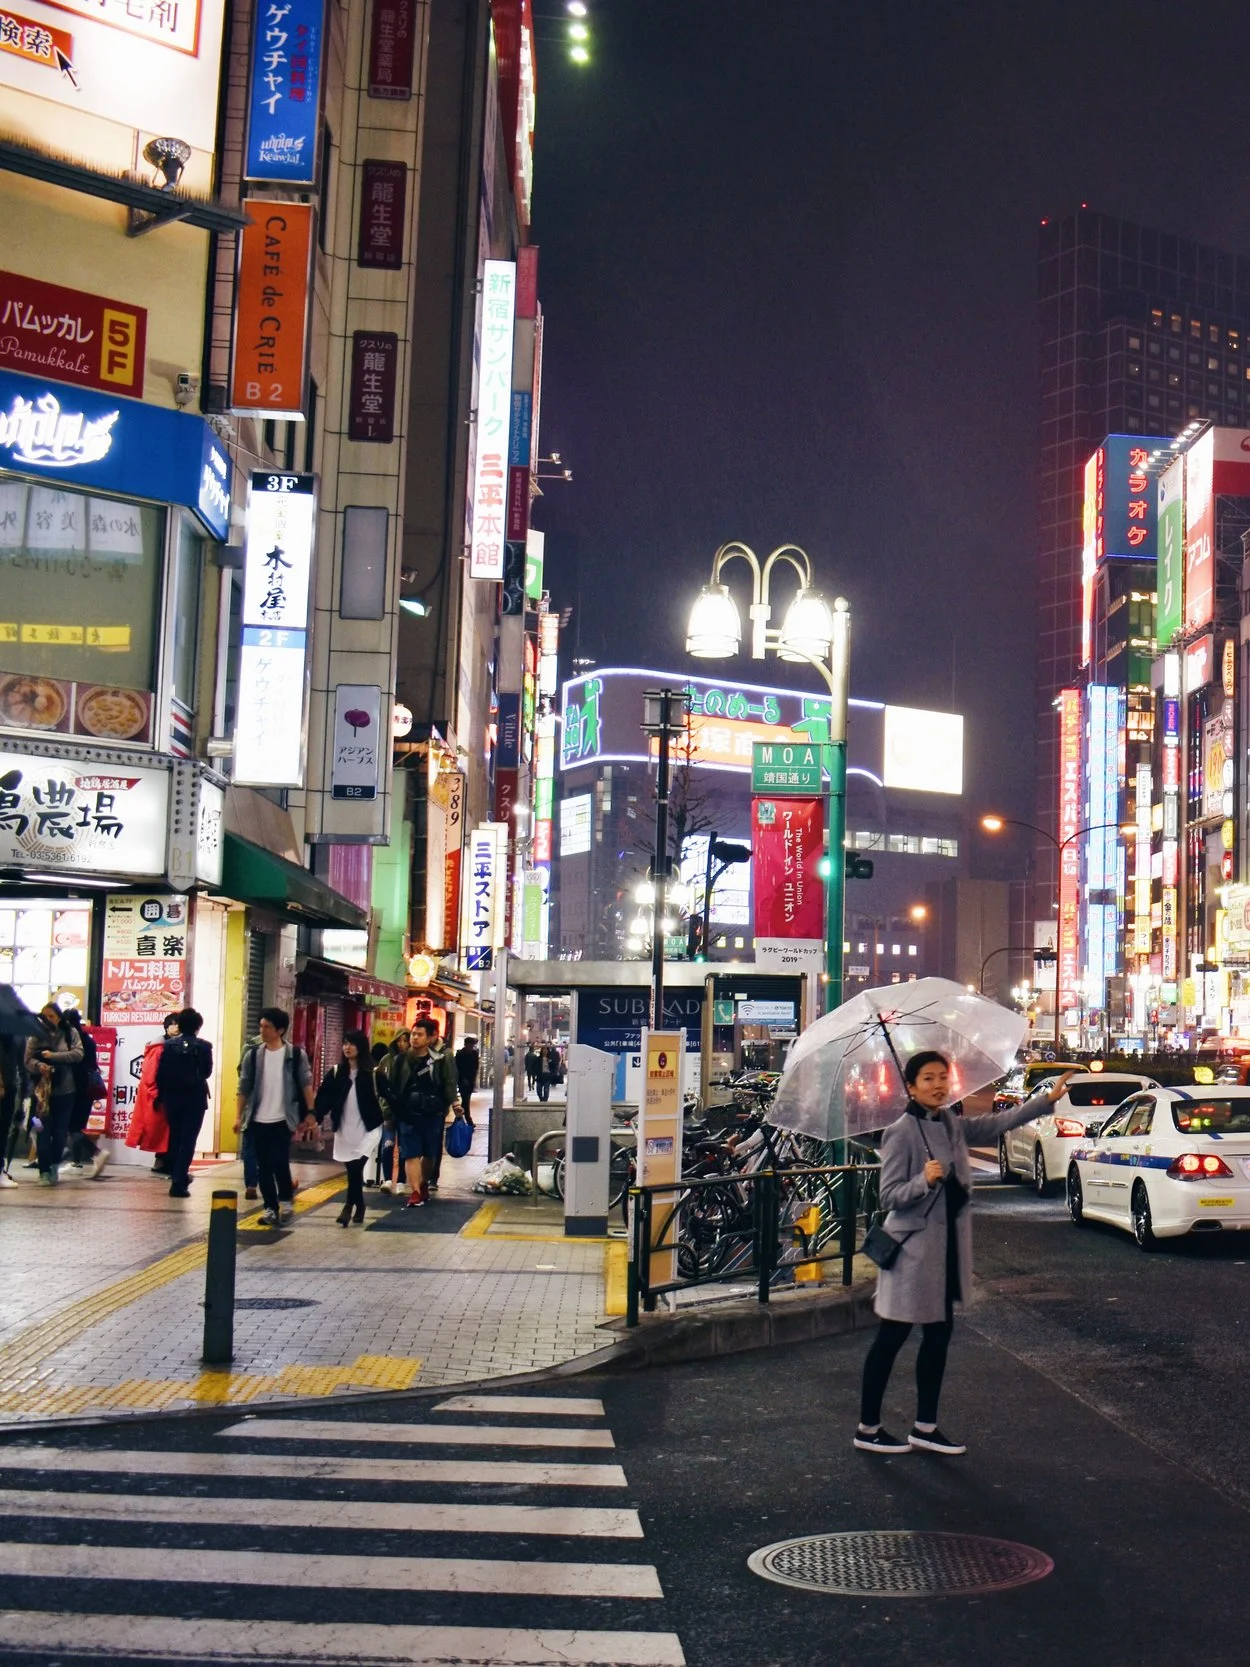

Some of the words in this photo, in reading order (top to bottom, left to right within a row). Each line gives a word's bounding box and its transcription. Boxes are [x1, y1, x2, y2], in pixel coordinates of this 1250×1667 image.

[0, 15, 52, 57] 検索
[260, 4, 292, 115] ゲウチャイ
[370, 182, 394, 247] 龍生堂
[262, 281, 283, 307] de
[1, 300, 94, 345] パムッカレ
[106, 320, 131, 377] 5F
[484, 273, 512, 438] 新宿サンパーク
[361, 352, 386, 413] 龍生堂
[266, 475, 299, 493] 3F
[1128, 448, 1149, 545] カラオケ
[475, 453, 503, 568] 三平本館
[1188, 532, 1211, 574] アコム
[258, 629, 290, 647] 2F
[682, 684, 781, 725] たのめーる
[337, 746, 375, 757] アジアン
[763, 771, 811, 784] 靖国通り
[450, 777, 461, 826] 389
[1065, 761, 1078, 844] エスパス
[795, 828, 803, 843] The
[795, 845, 803, 869] World
[473, 841, 492, 938] 三平ストア
[796, 881, 804, 905] Union
[136, 935, 185, 957] 喜楽
[468, 947, 482, 956] B1
[762, 946, 818, 955] ラグビーワールドカップ
[107, 960, 181, 979] トルコ料理
[478, 959, 492, 969] B2
[122, 978, 165, 990] パムッカレ
[103, 1012, 130, 1023] TURKISH
